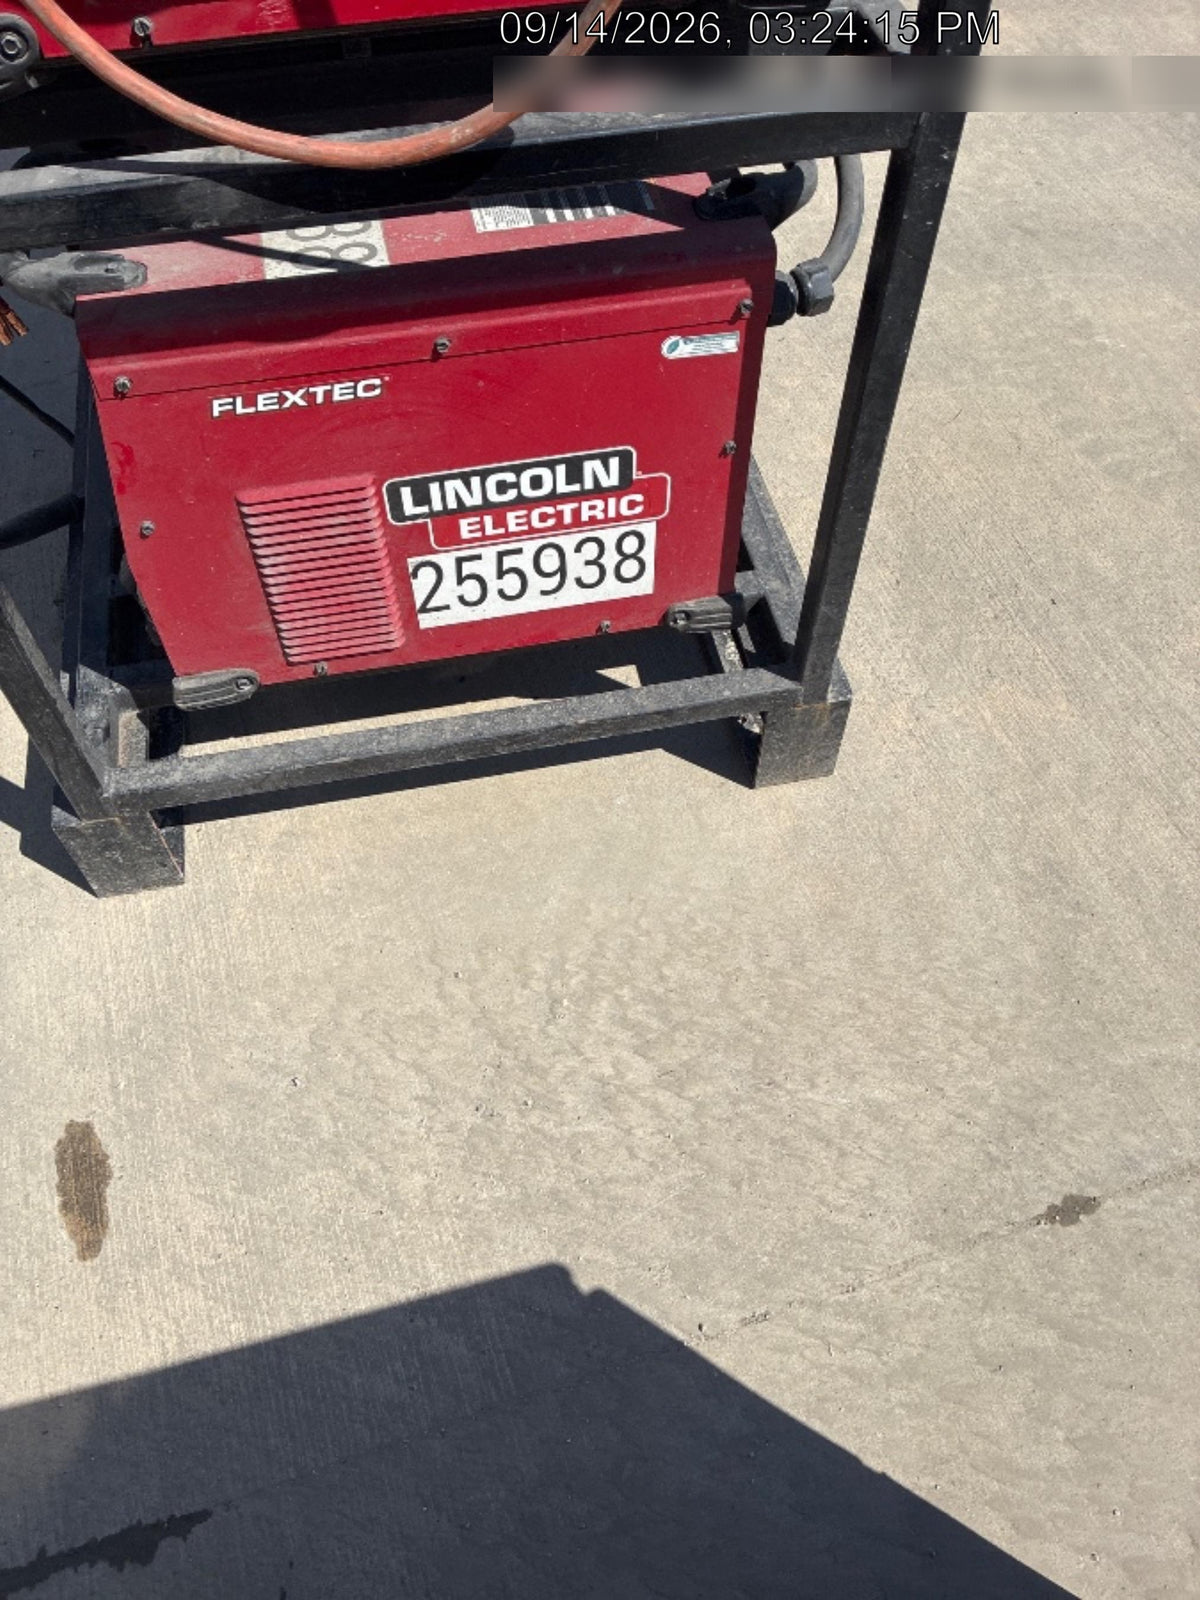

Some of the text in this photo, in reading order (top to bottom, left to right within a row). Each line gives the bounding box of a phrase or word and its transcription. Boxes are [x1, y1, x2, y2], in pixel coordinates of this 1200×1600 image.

[212, 377, 383, 418] FLEXTEC
[400, 456, 620, 517] LINCOLN
[458, 493, 645, 540] ELECTRIC
[410, 529, 647, 615] 255938
